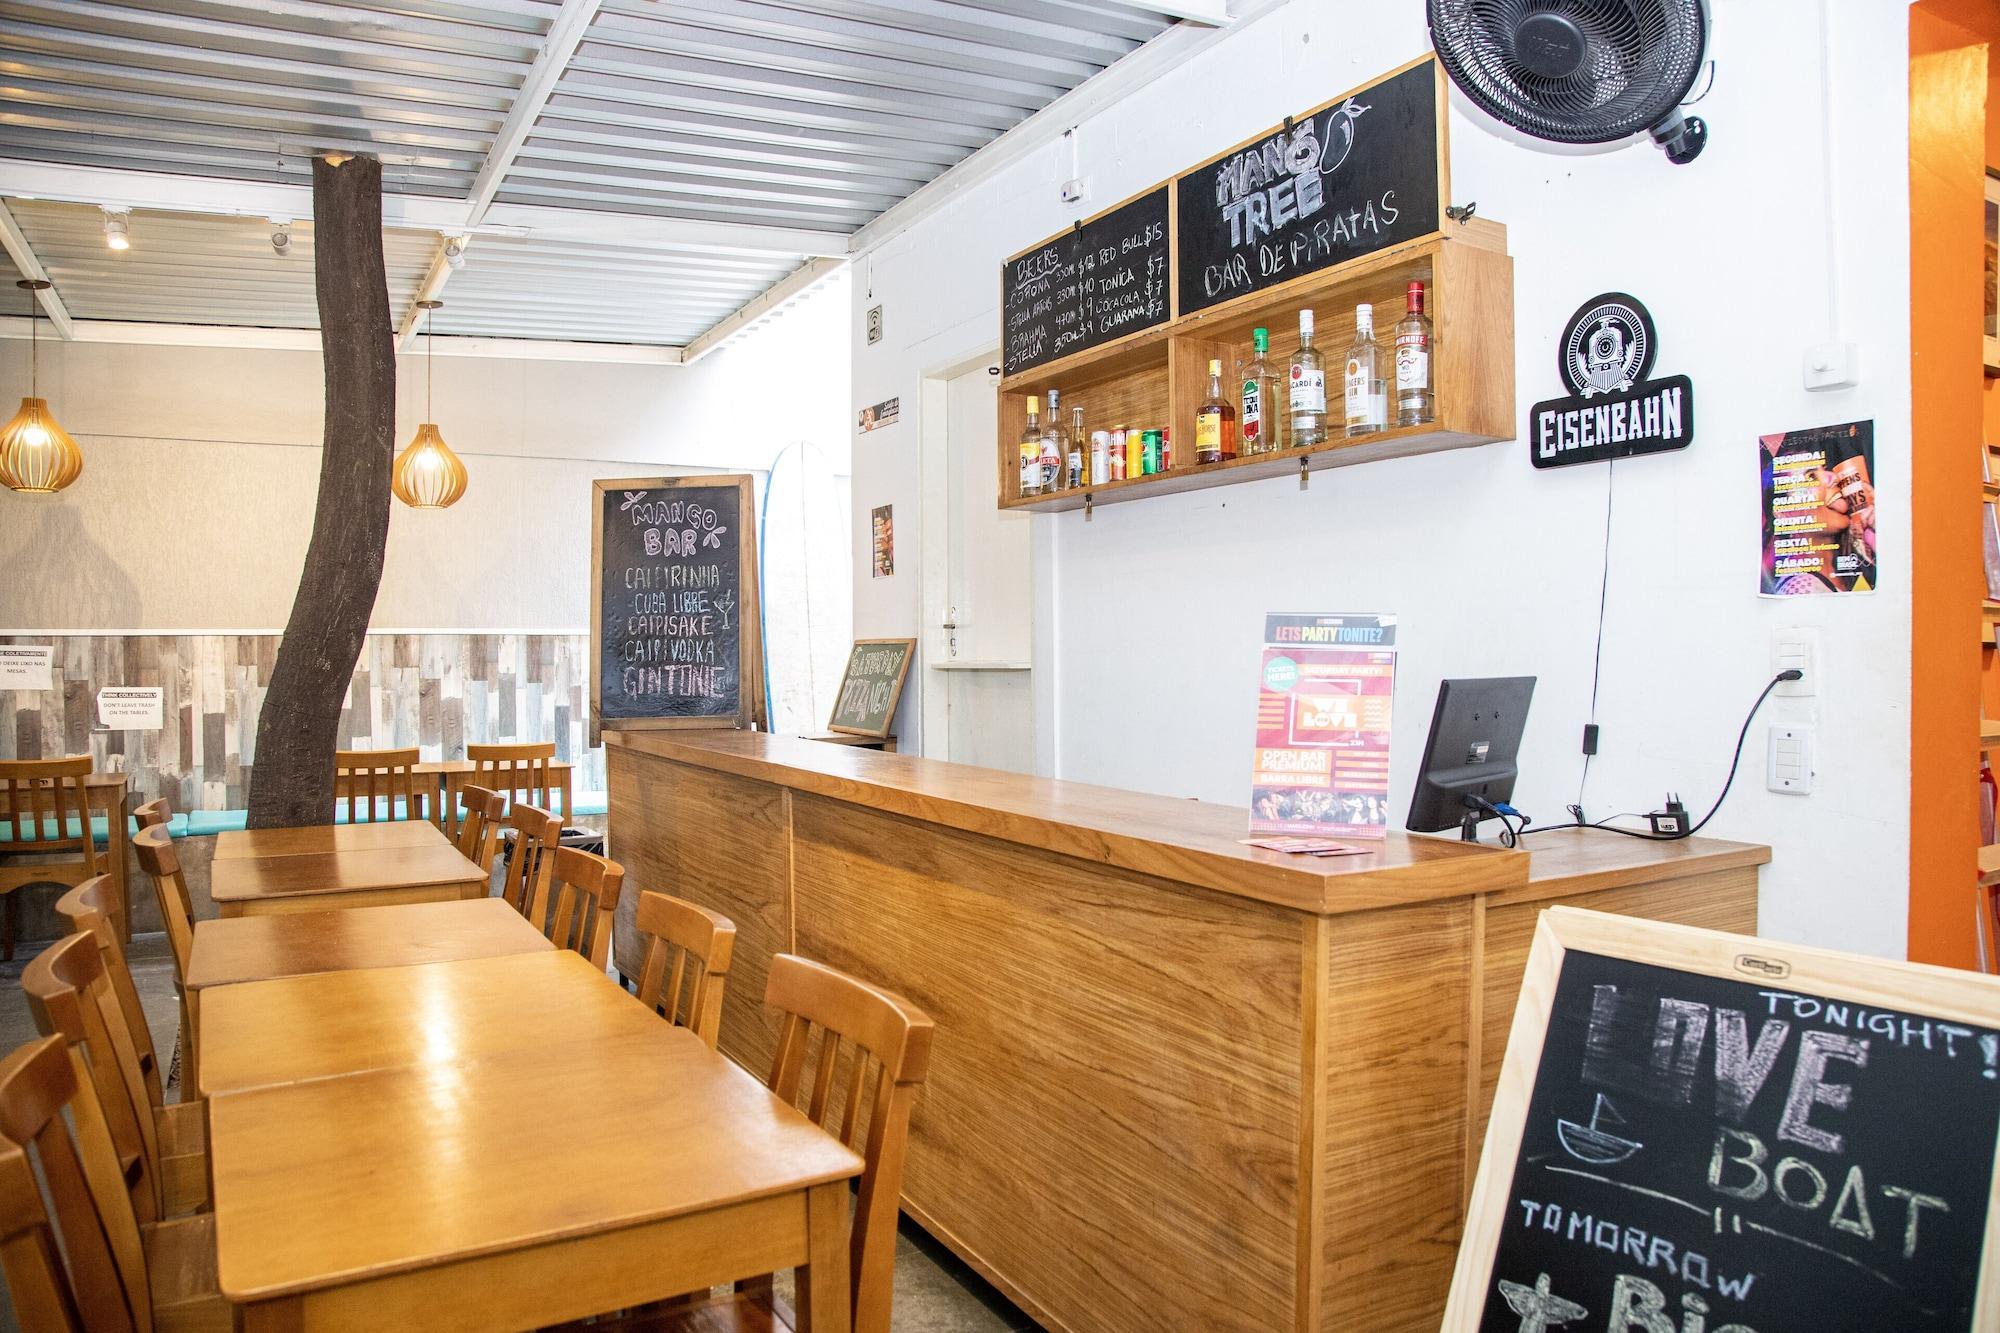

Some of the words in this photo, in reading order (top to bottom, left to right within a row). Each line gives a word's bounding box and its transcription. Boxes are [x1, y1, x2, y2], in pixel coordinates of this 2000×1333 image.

[1222, 166, 1324, 248] TREE
[1099, 246, 1117, 266] RED
[1122, 234, 1143, 254] BULL
[1144, 221, 1163, 247] $15
[1205, 253, 1252, 297] BAR
[1260, 244, 1286, 276] DE
[1290, 190, 1399, 266] PIRATAS
[1016, 247, 1059, 285] BEERS
[1078, 254, 1095, 278] $12
[1147, 256, 1164, 278] $7
[1078, 278, 1094, 301] $10
[1144, 278, 1163, 299] $7
[1101, 305, 1145, 333] GUARANA
[1146, 299, 1163, 318] $7
[1539, 387, 1683, 458] EISENBAHN
[632, 501, 717, 530] MANGO
[644, 528, 698, 557] BAR
[634, 592, 666, 614] CUBA
[673, 591, 711, 613] LIBRE
[1302, 712, 1357, 728] LOVE
[1262, 750, 1297, 760] OPEN
[1300, 751, 1326, 761] BAR
[1759, 991, 2000, 1080] TONIGHT!
[1707, 1127, 1952, 1260] BOAT
[1520, 1198, 1757, 1301] TOMORROW
